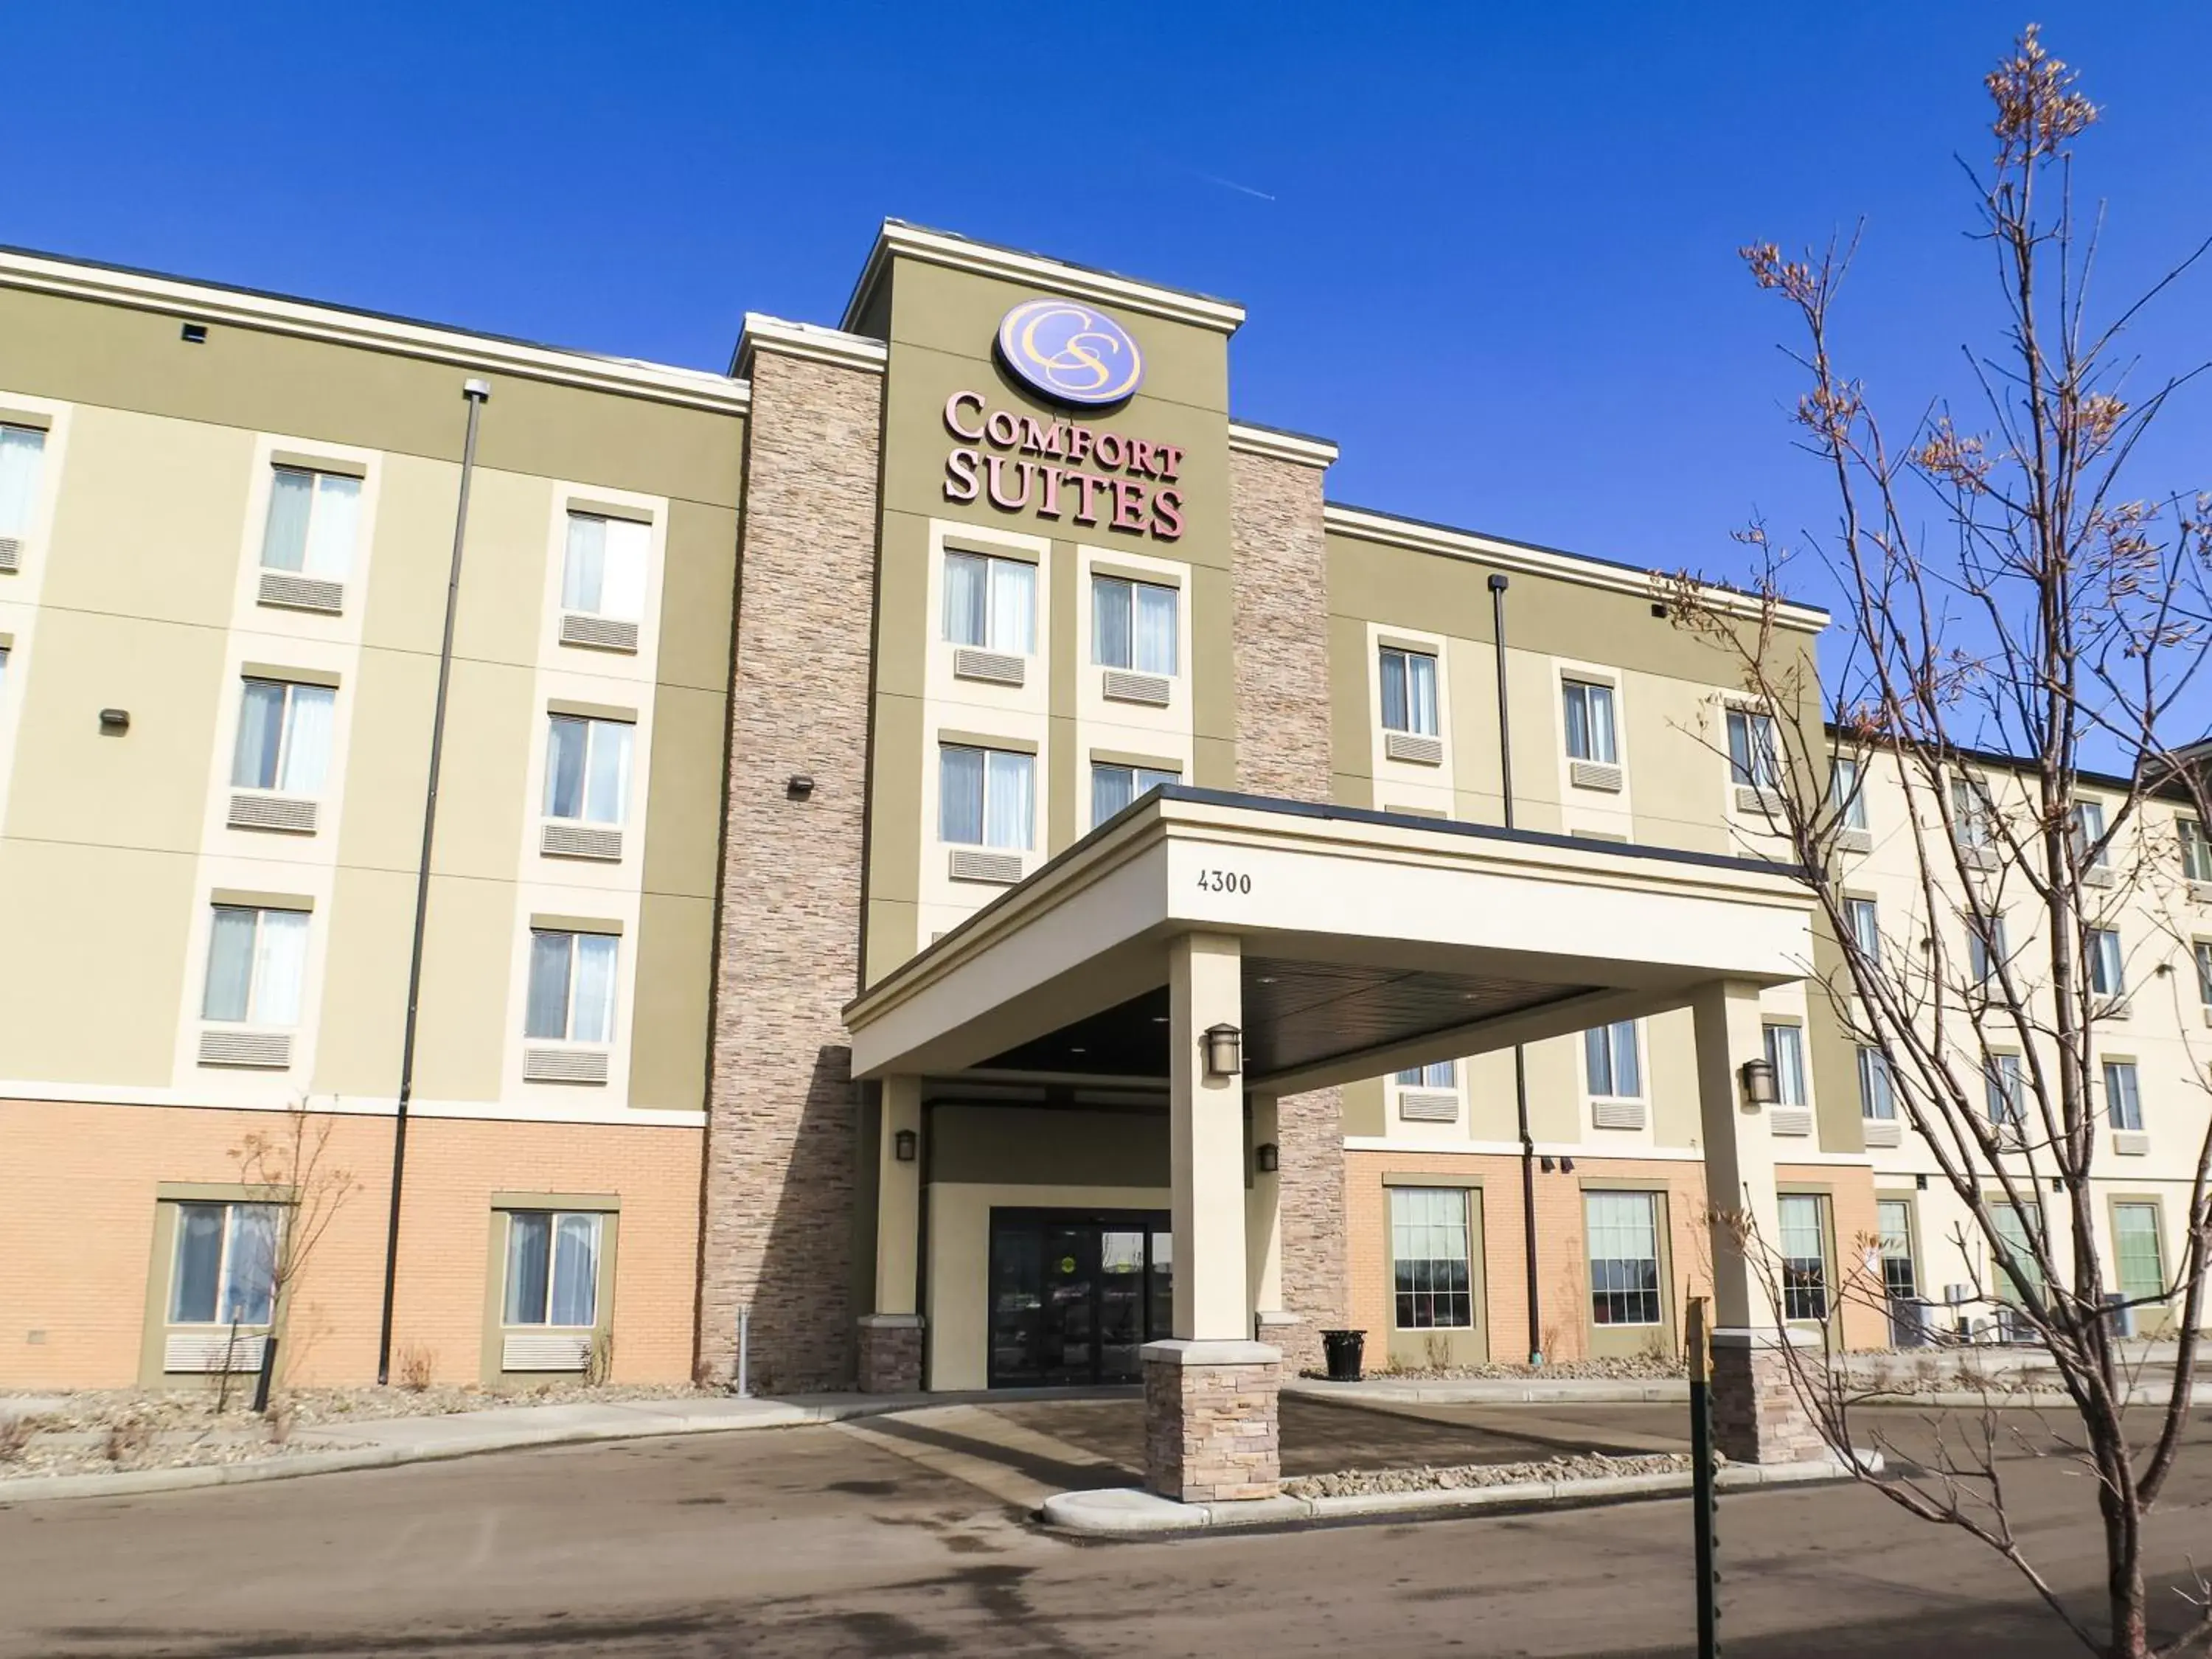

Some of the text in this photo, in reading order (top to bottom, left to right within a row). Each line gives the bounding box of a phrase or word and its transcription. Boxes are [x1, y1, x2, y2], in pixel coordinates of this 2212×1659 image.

[944, 390, 1186, 479] COMFORT
[945, 448, 1185, 538] SUITES
[1197, 869, 1251, 894] 4300
